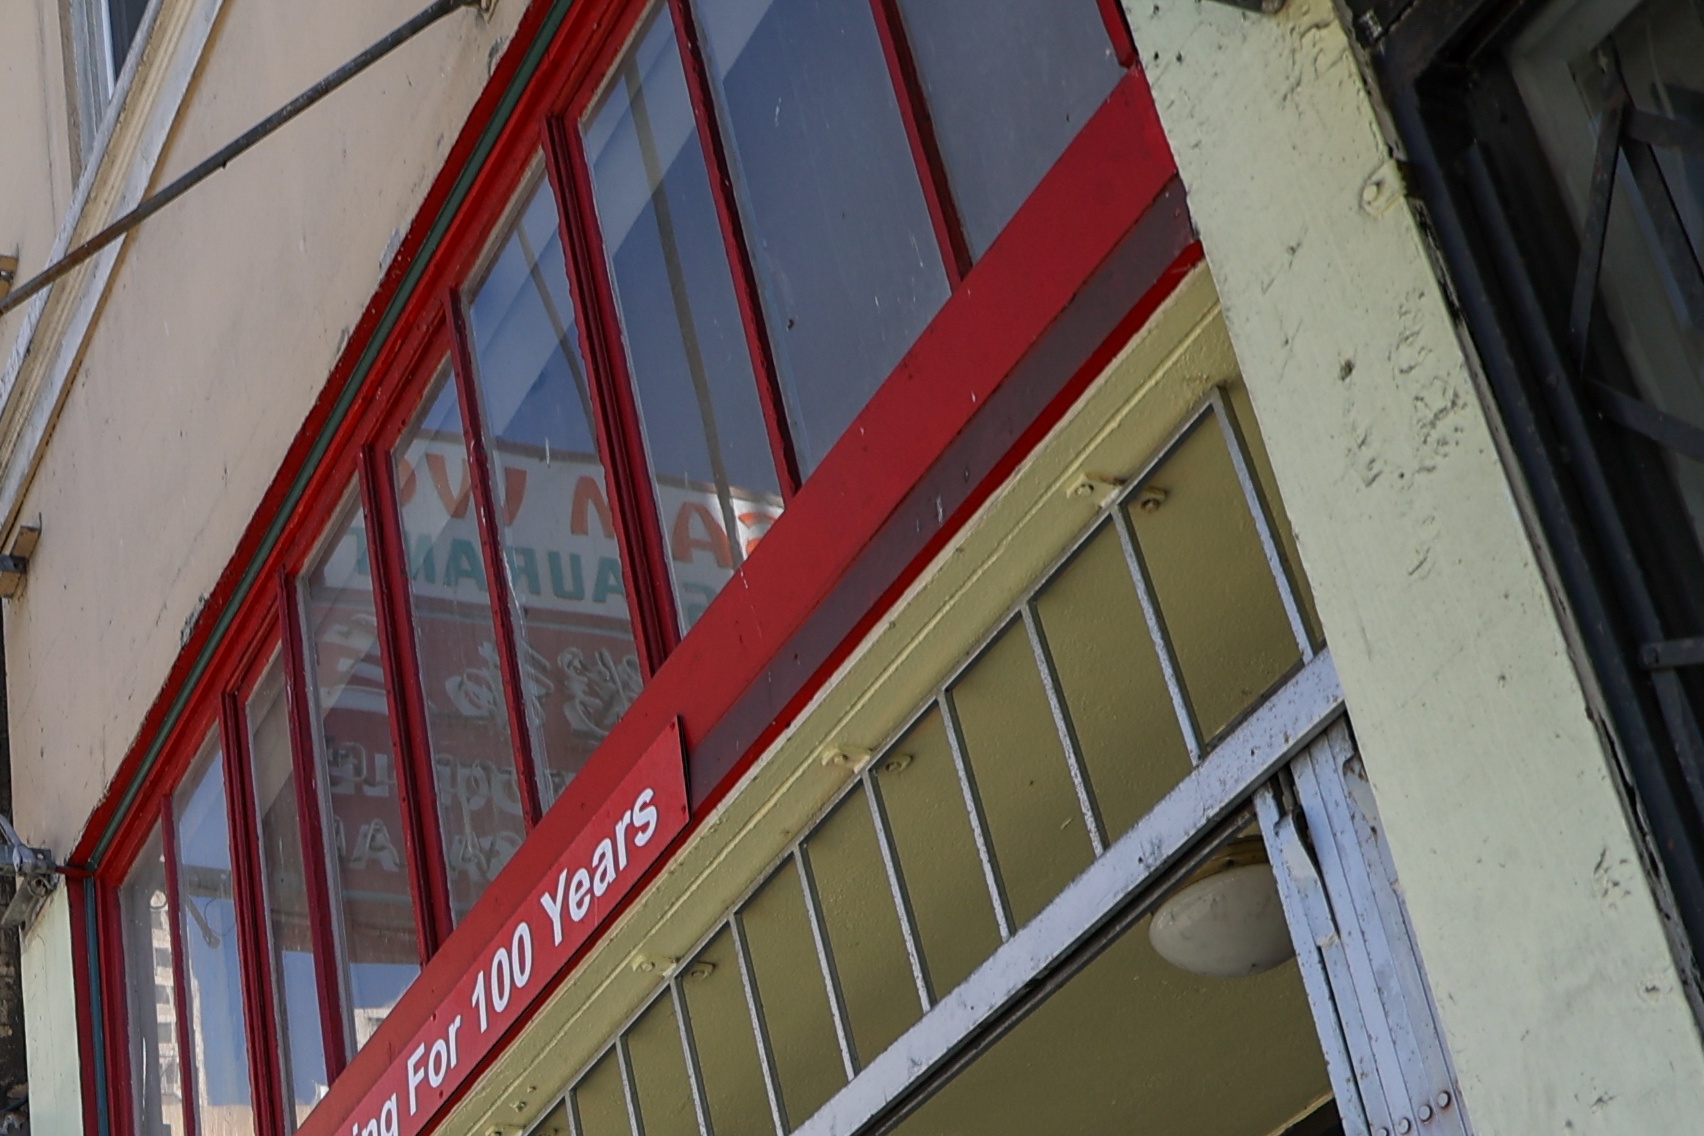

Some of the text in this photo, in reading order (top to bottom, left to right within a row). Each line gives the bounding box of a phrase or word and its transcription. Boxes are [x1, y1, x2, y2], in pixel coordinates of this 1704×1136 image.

[407, 1014, 462, 1116] For
[472, 922, 533, 1034] 100
[541, 787, 659, 947] Years
